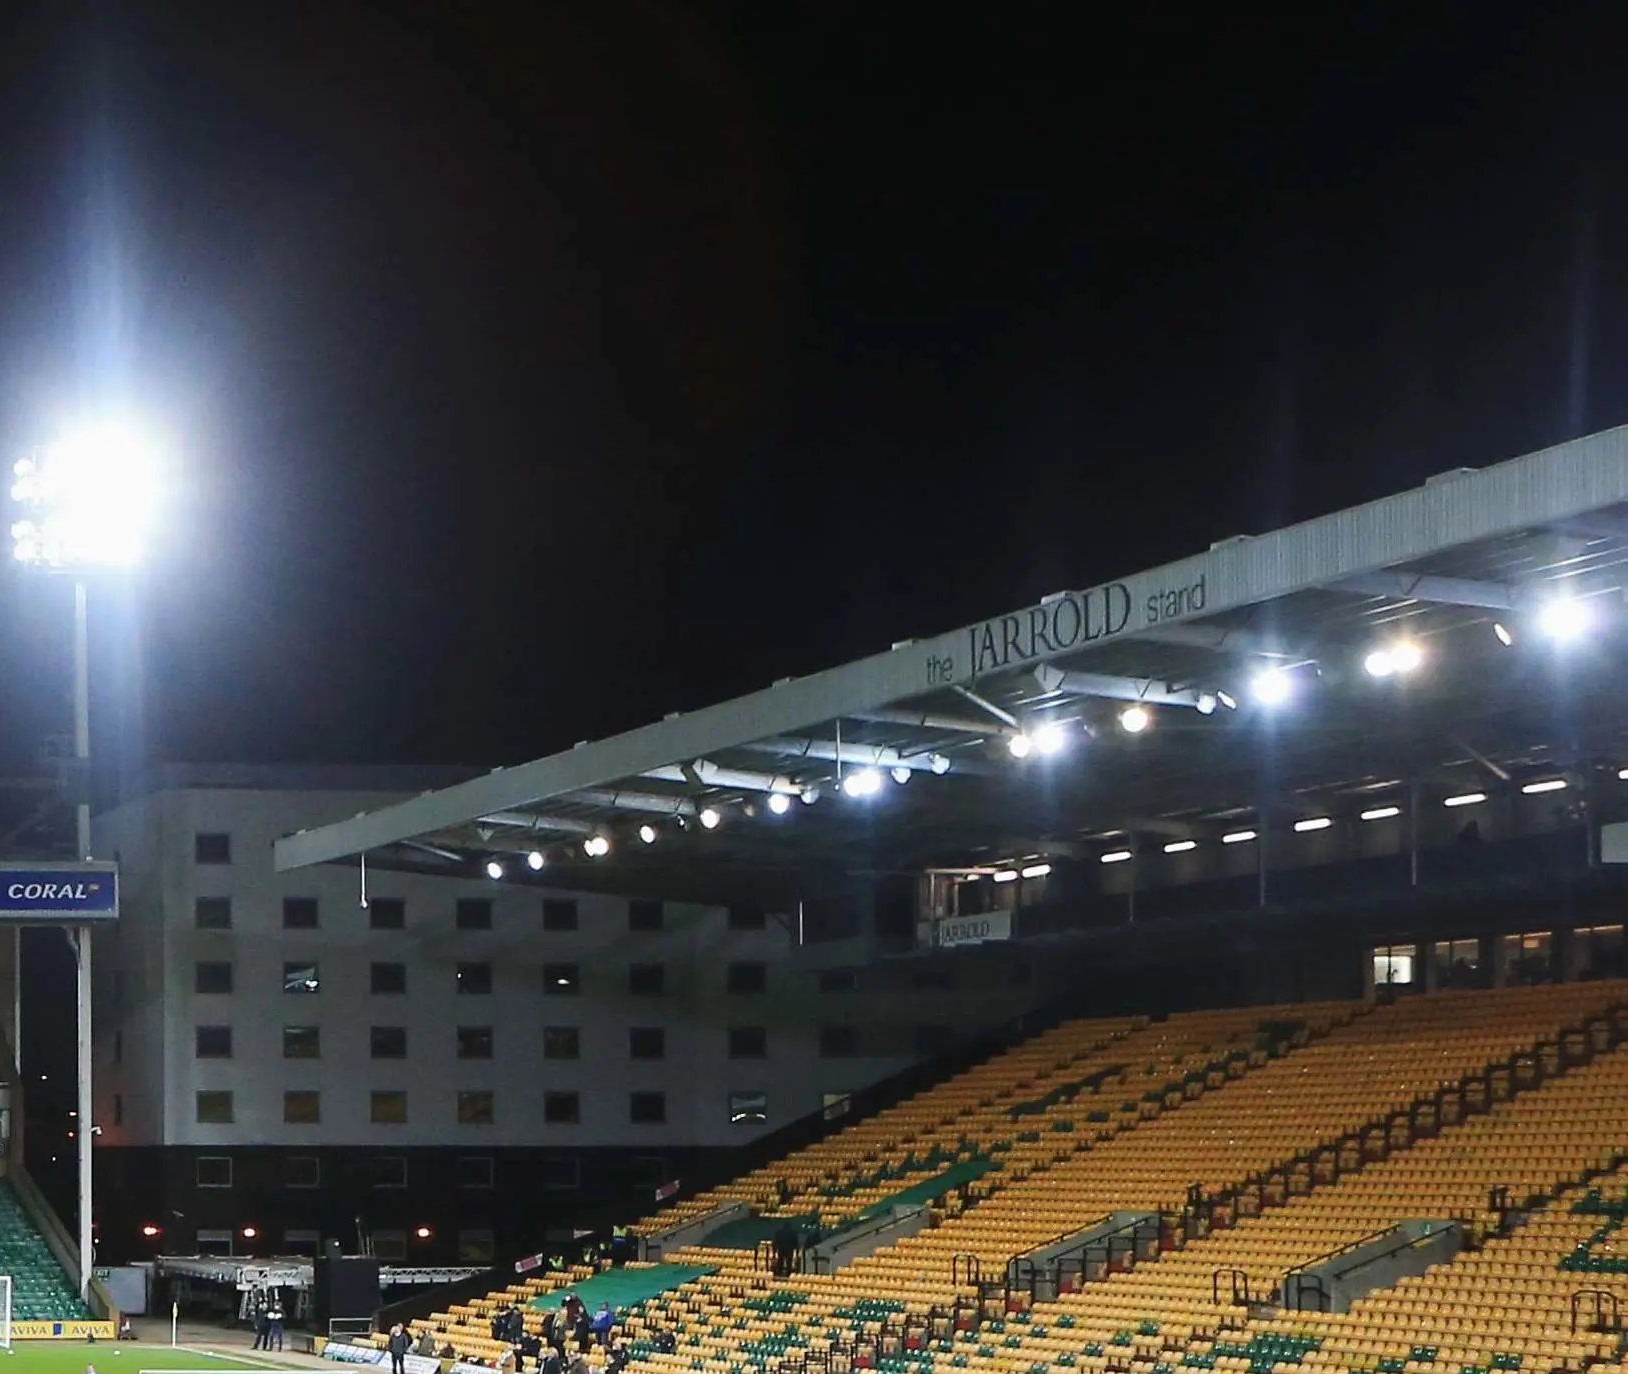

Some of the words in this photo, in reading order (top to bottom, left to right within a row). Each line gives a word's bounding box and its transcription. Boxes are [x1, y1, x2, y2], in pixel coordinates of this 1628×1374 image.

[927, 655, 953, 683] the
[968, 583, 1132, 688] JARROLD
[1147, 574, 1206, 623] stand
[8, 883, 88, 899] CORAL
[72, 1326, 110, 1335] AVIVA
